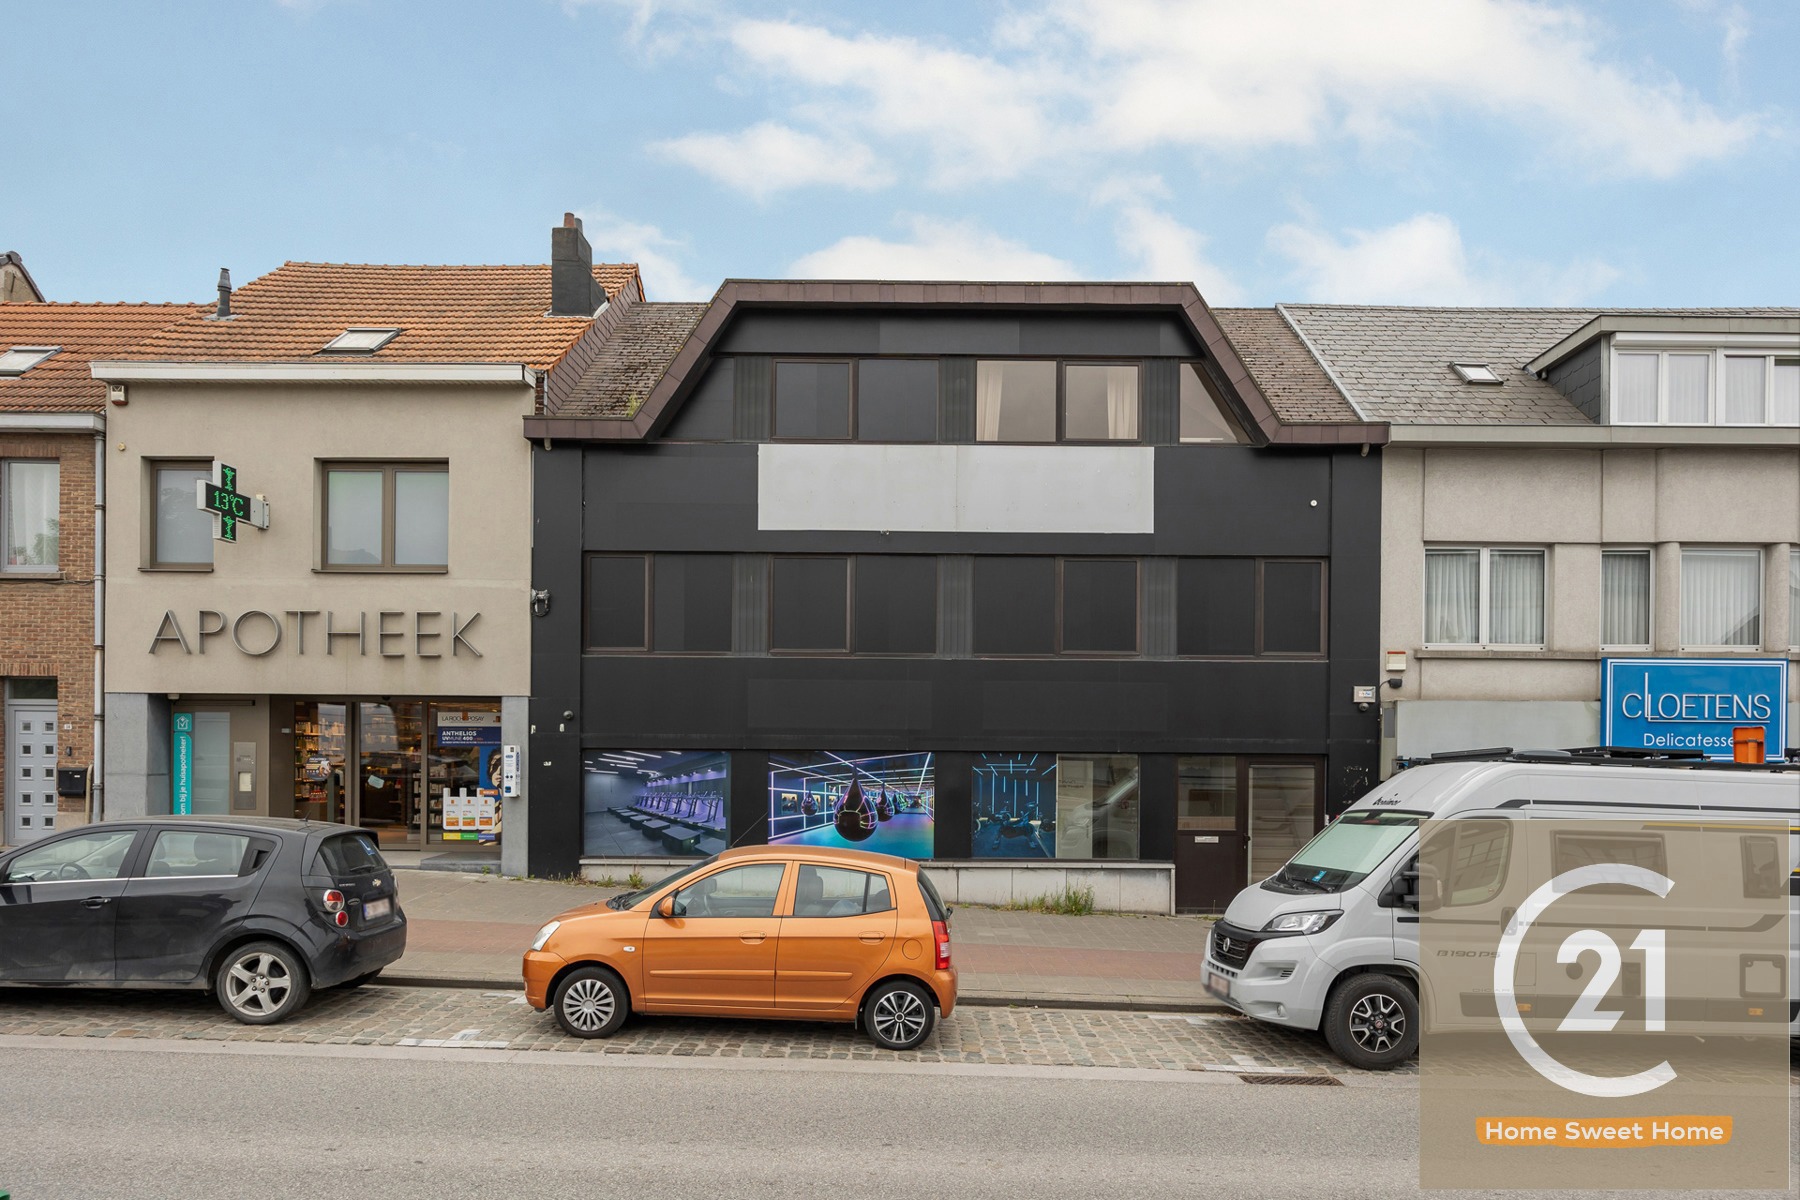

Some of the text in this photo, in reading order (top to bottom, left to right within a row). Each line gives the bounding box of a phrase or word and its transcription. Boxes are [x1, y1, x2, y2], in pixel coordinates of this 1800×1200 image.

[214, 490, 244, 516] 13°C
[148, 610, 483, 657] APOTHEEK
[1621, 672, 1771, 720] CLOETENS
[1643, 733, 1734, 747] Delicatesse
[179, 794, 187, 802] bij
